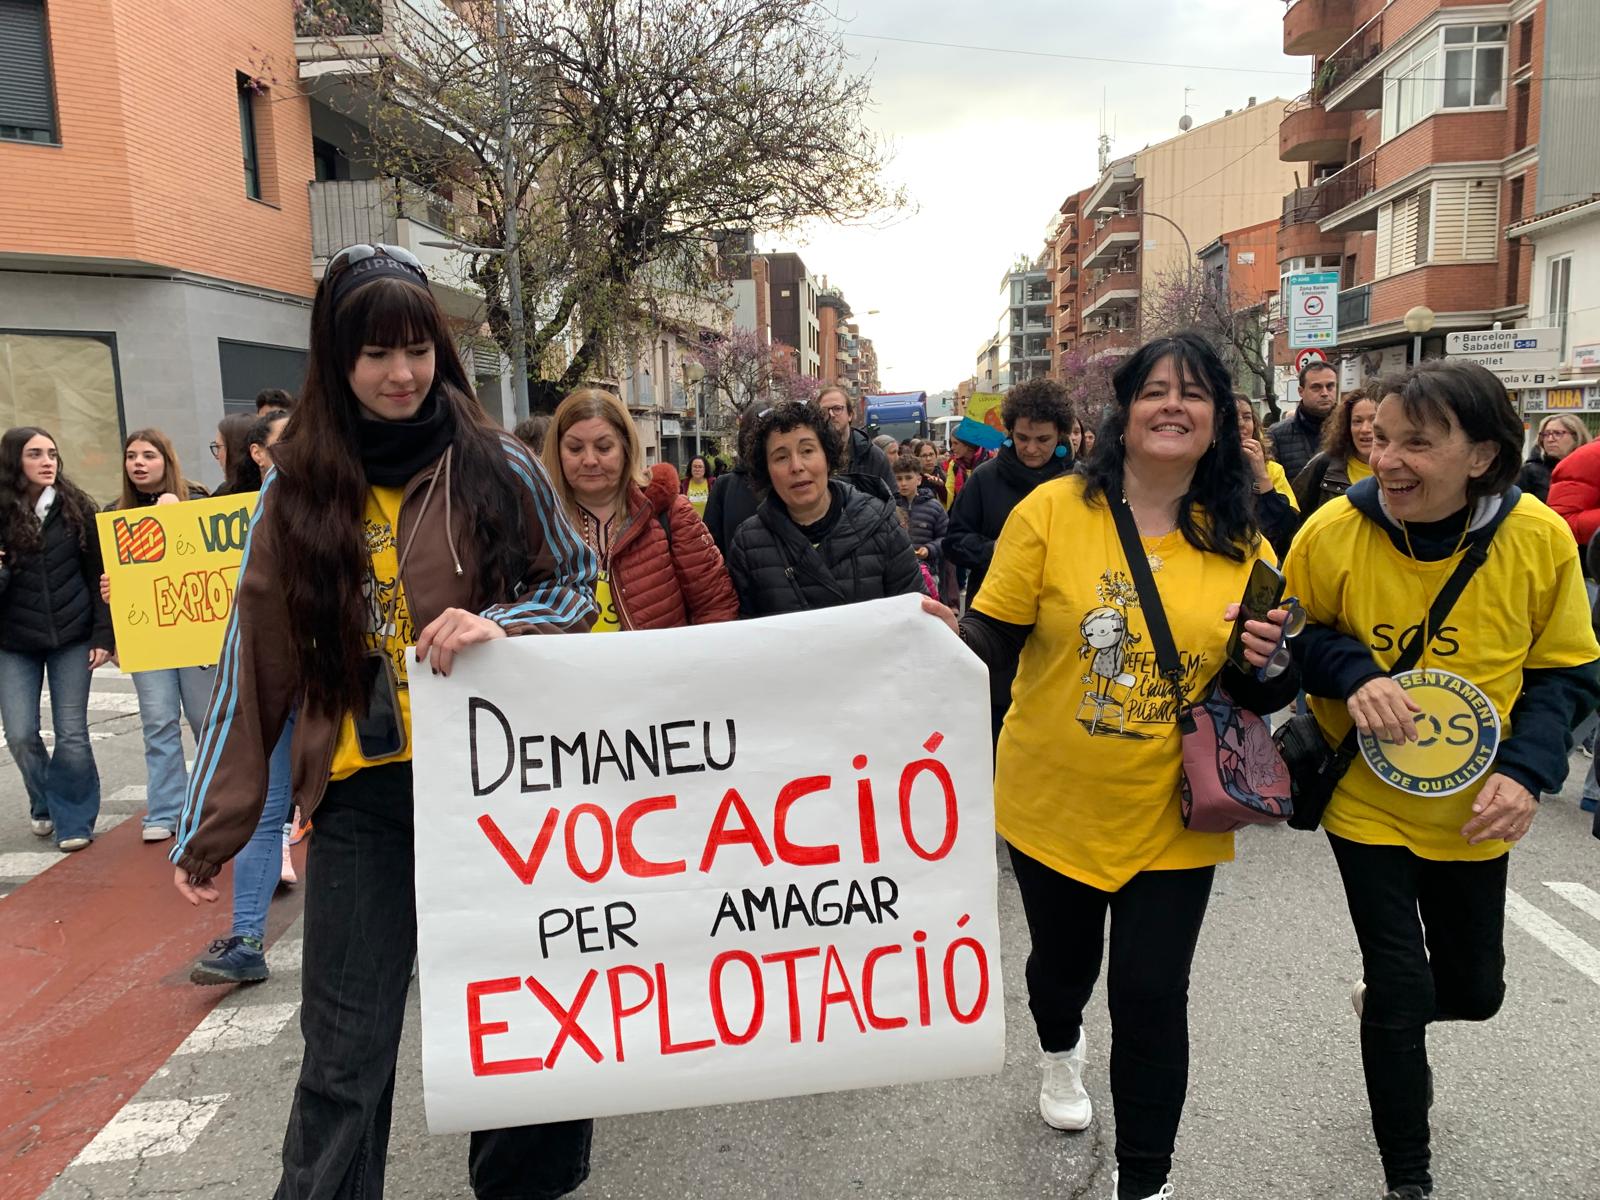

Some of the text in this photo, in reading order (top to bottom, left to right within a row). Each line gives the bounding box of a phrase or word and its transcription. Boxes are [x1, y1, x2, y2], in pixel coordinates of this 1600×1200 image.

[352, 258, 414, 276] KIPRU
[1462, 332, 1519, 342] Barcelona
[1462, 340, 1536, 351] Sabadell C-58
[113, 507, 250, 565] NO és VOCA
[128, 565, 241, 627] és EXPLOT
[1400, 673, 1496, 729] SENYAMENT
[467, 696, 736, 797] DEMANEU
[1379, 713, 1474, 747] OS
[1363, 737, 1492, 792] BLIC DE QUALITAT
[538, 875, 899, 959] PER AMAGAR
